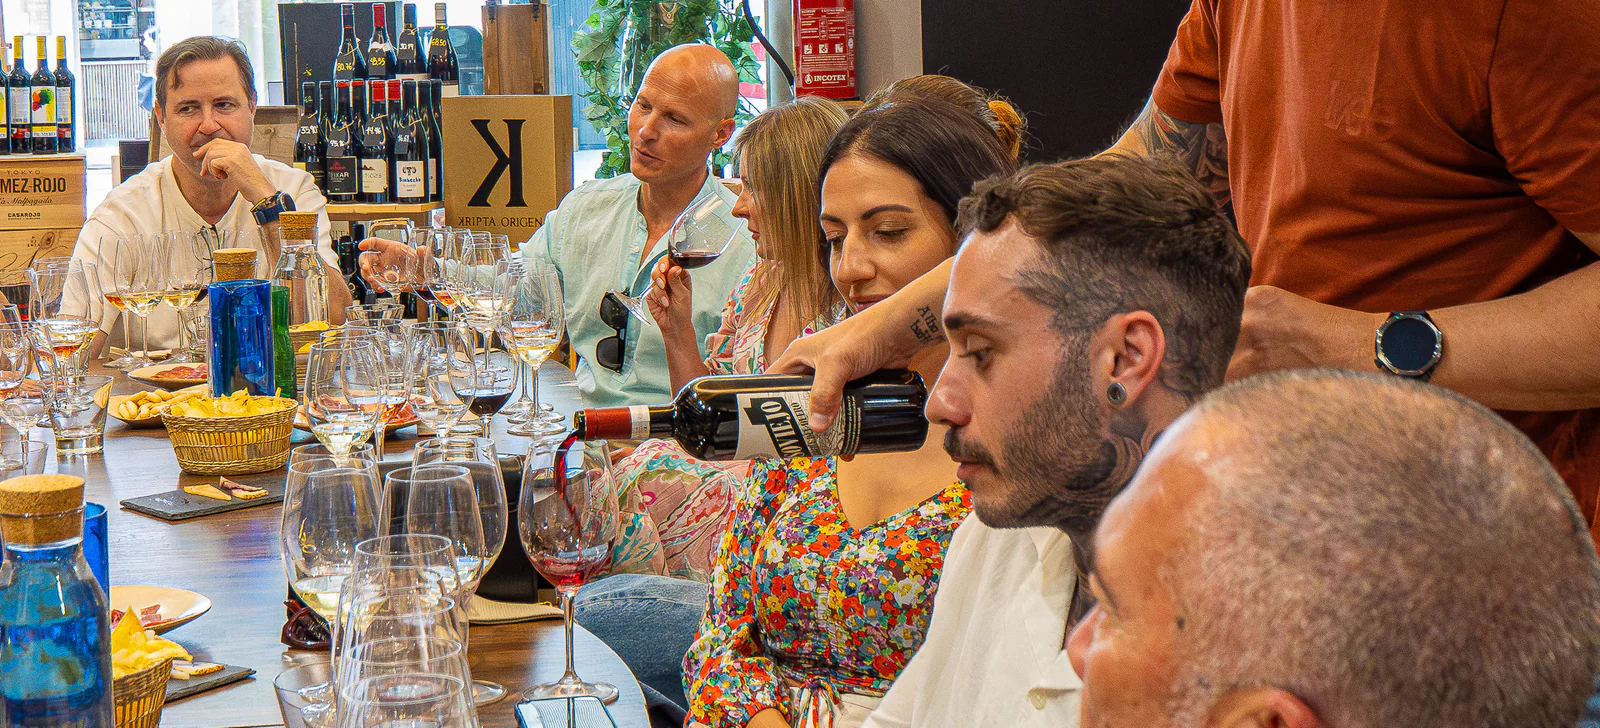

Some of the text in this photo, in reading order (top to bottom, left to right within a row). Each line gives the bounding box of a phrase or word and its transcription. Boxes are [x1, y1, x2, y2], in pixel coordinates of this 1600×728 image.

[813, 74, 846, 82] INCOTEX
[458, 216, 544, 228] KRIPTA ORIGEN
